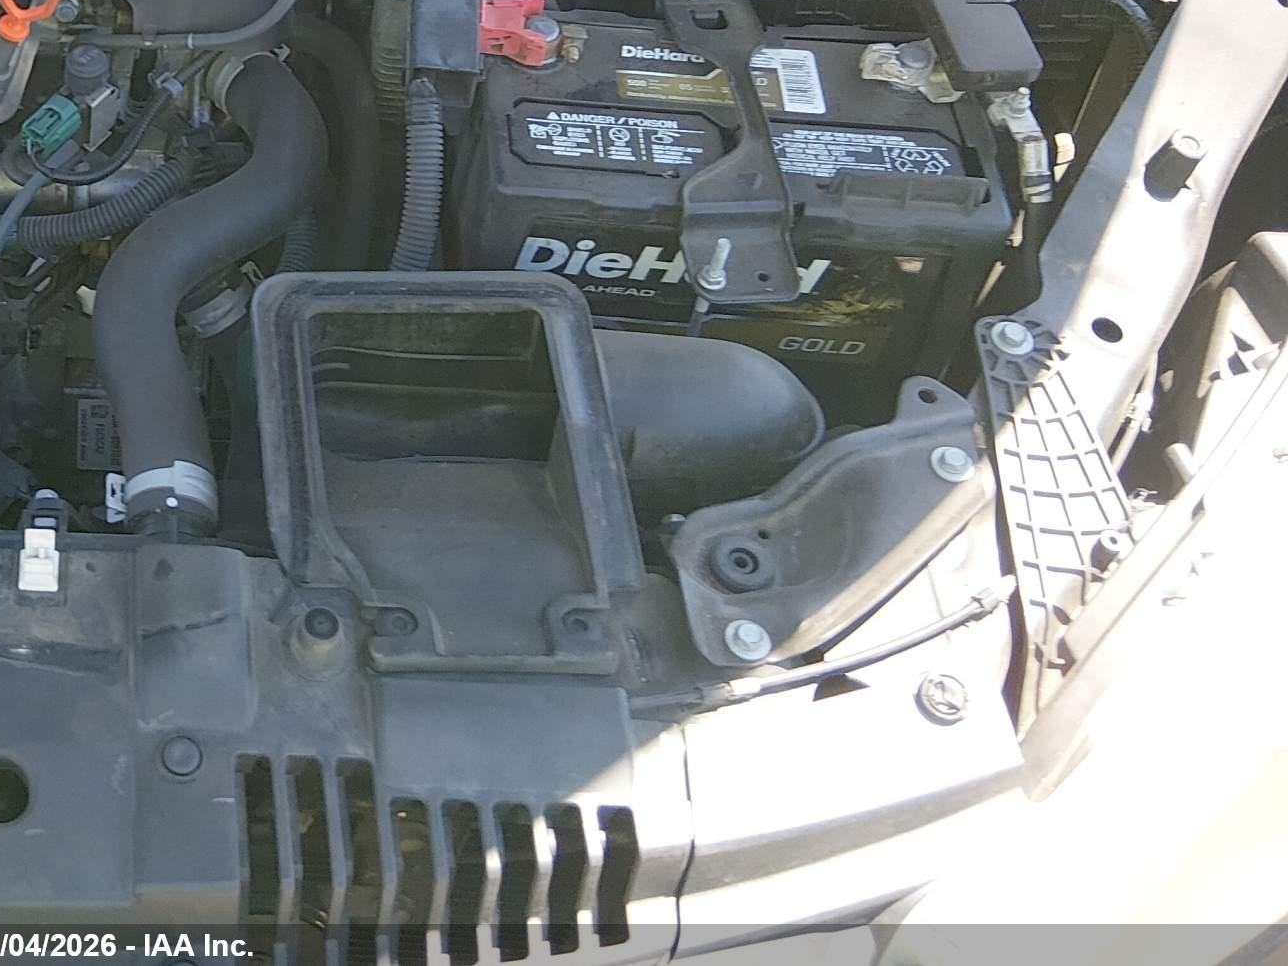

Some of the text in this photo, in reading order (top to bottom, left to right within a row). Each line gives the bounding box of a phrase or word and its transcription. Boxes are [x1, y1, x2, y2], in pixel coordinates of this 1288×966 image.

[560, 112, 616, 125] DANGER
[627, 117, 679, 129] POISON
[513, 236, 831, 294] DieHd
[581, 284, 657, 297] AHEAD
[777, 335, 866, 356] GOLD
